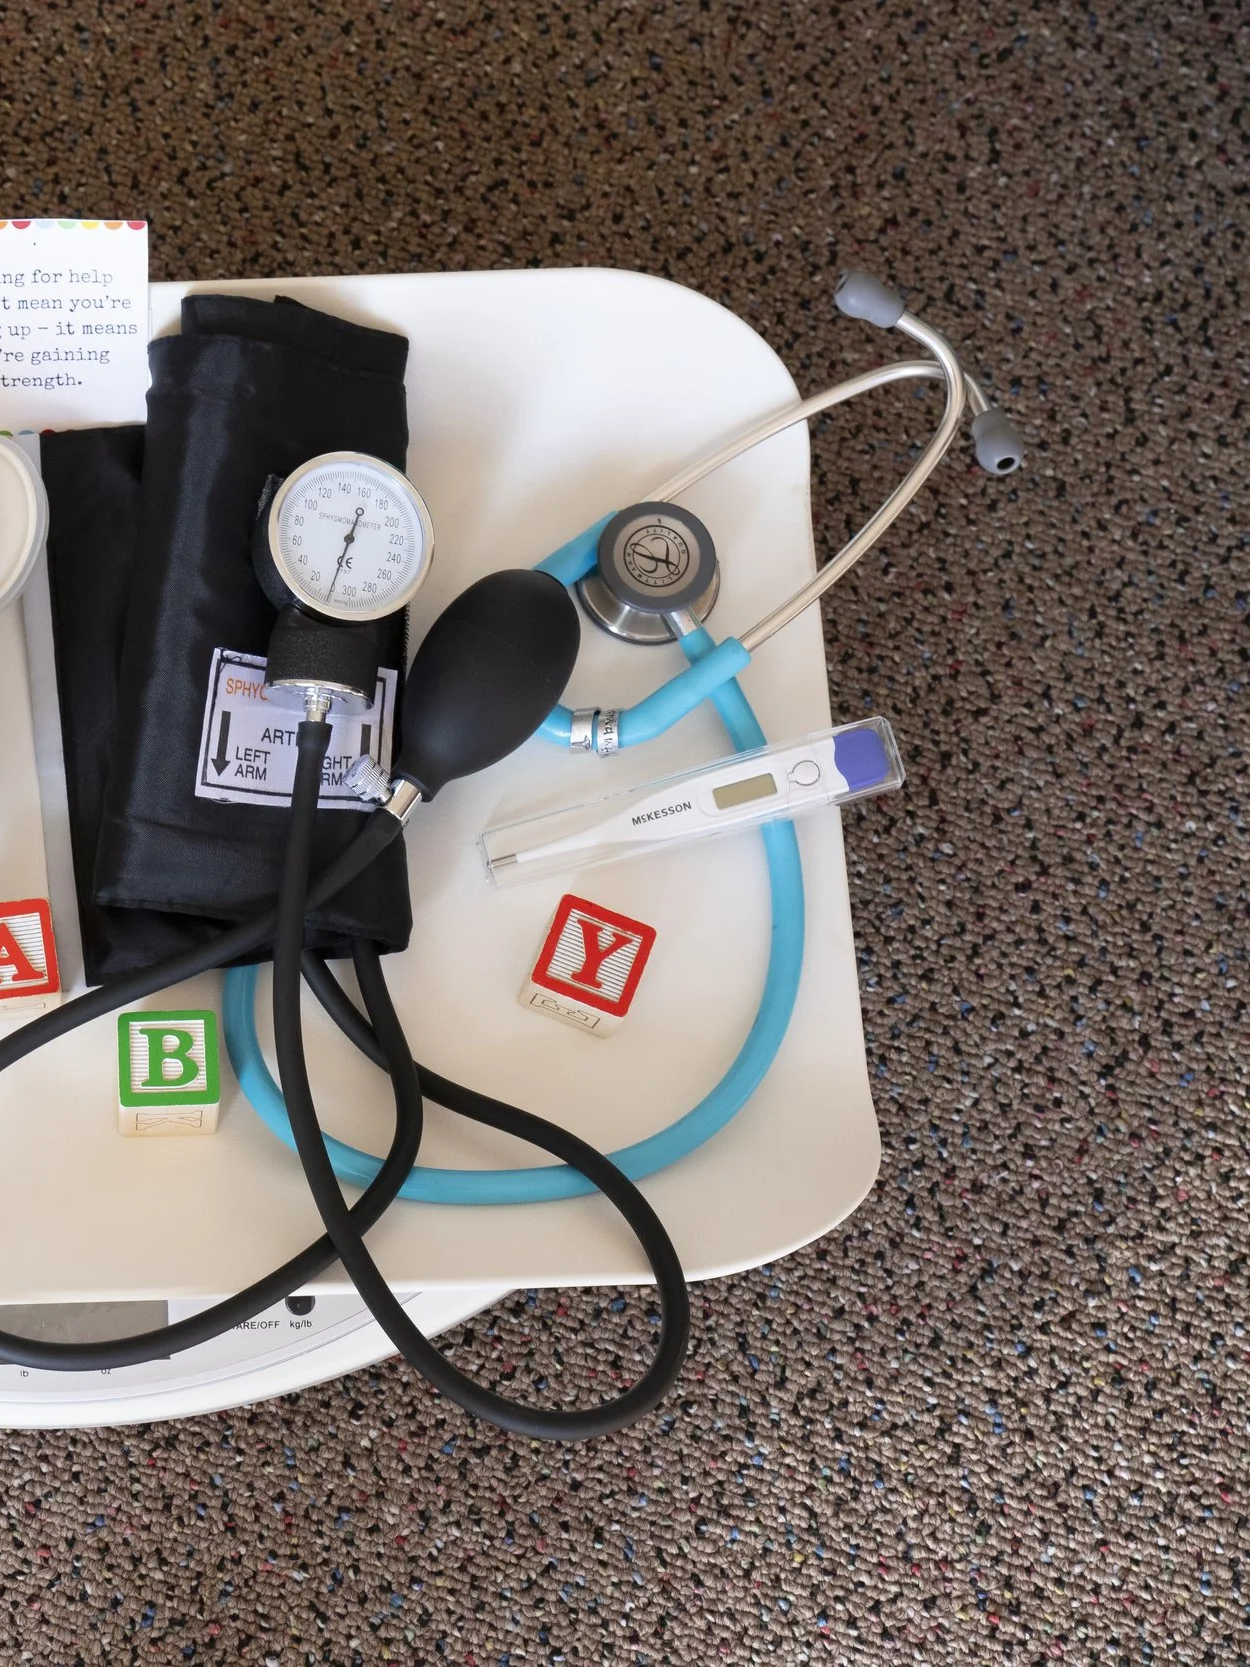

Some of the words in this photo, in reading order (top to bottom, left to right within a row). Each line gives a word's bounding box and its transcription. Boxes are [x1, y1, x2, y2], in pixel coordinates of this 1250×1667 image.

[31, 269, 63, 284] for
[69, 269, 113, 287] help
[17, 299, 63, 309] mean
[70, 295, 132, 312] you're
[8, 325, 31, 340] up
[55, 321, 75, 335] it
[82, 325, 138, 335] means
[30, 347, 110, 365] gaining
[318, 487, 332, 499] 120
[338, 482, 352, 495] 140
[357, 487, 371, 499] 160
[304, 499, 318, 511] 100
[375, 499, 389, 511] 180
[294, 515, 304, 526] 80
[318, 511, 382, 531] SPHYGMOMAOMETER
[384, 516, 400, 529] 200
[292, 535, 302, 546] 60
[389, 534, 404, 546] 220
[646, 528, 686, 555] QUALITY
[297, 554, 308, 566] 40
[386, 551, 402, 564] 240
[376, 568, 392, 581] 260
[626, 551, 673, 585] LITTMANN
[310, 570, 321, 582] 20
[342, 584, 357, 597] 300
[362, 581, 377, 594] 280
[260, 727, 299, 747] ART
[235, 746, 271, 764] LEFT
[234, 765, 268, 781] ARM
[320, 772, 343, 786] RM
[570, 918, 633, 989] Y
[139, 1028, 200, 1087] B
[289, 1320, 312, 1330] kg/lb
[20, 1369, 30, 1378] lb
